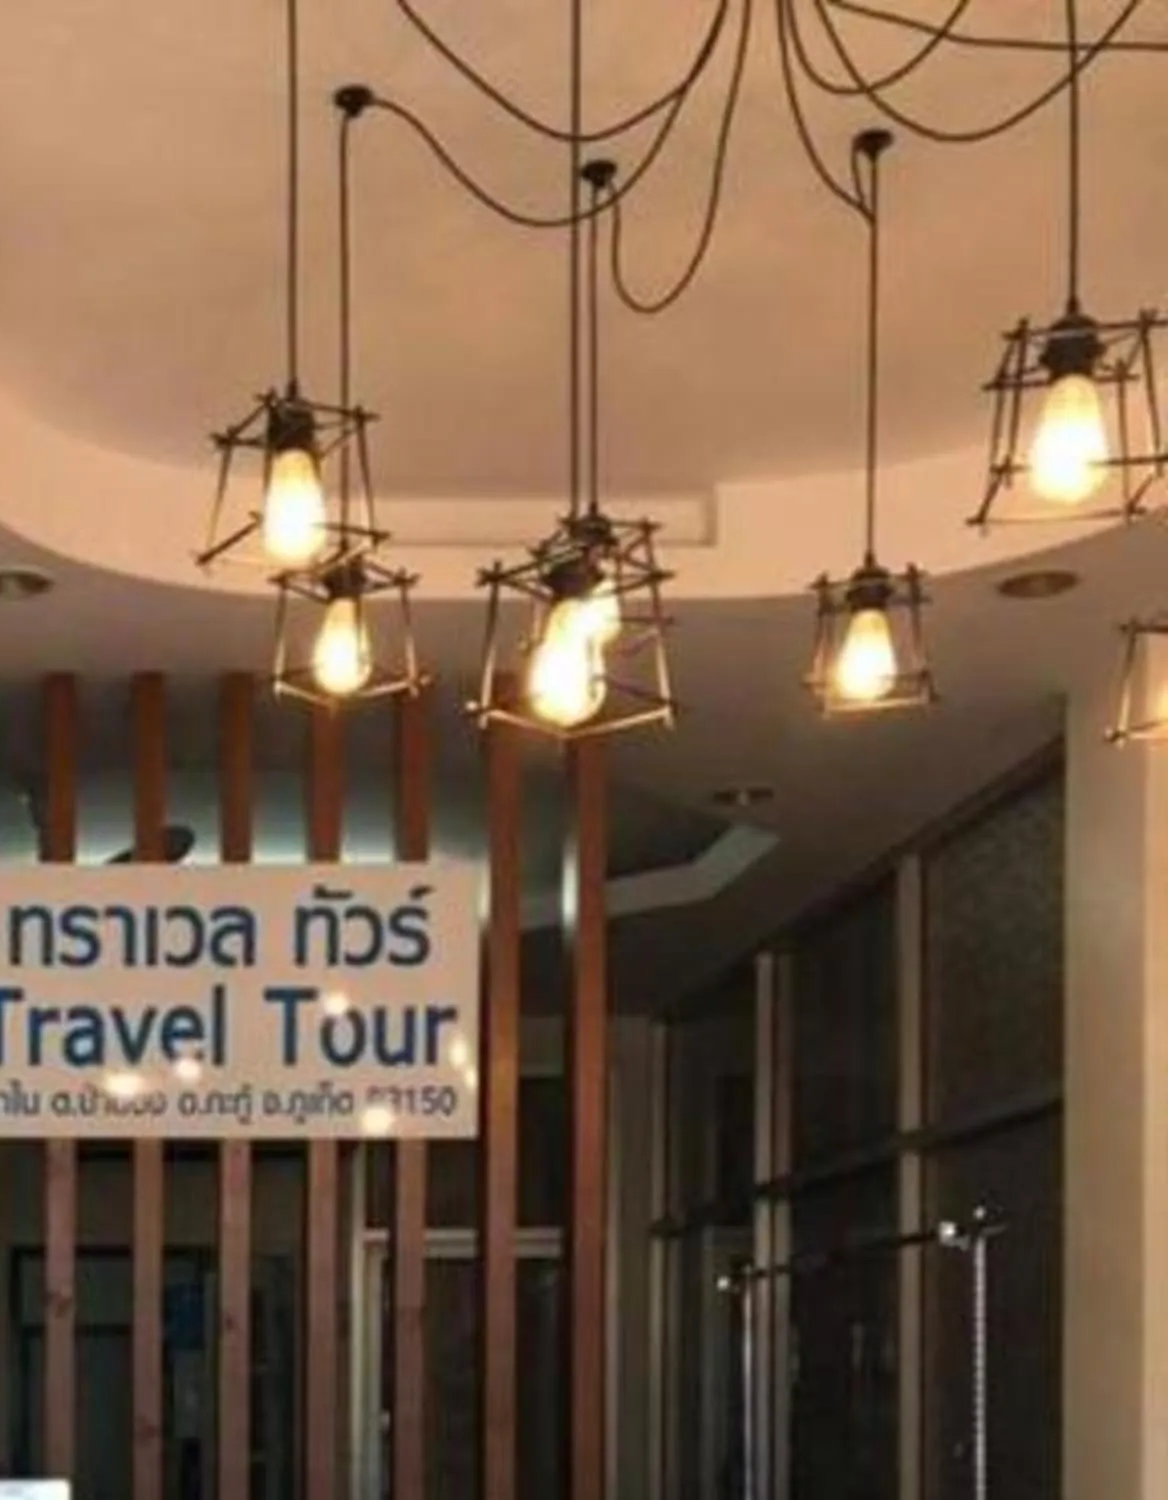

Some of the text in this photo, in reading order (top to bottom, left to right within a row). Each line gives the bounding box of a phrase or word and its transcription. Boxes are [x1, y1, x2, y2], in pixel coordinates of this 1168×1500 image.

[8, 904, 257, 967] ทราเวล
[293, 886, 432, 967] ทัวร์
[264, 986, 459, 1068] Tour
